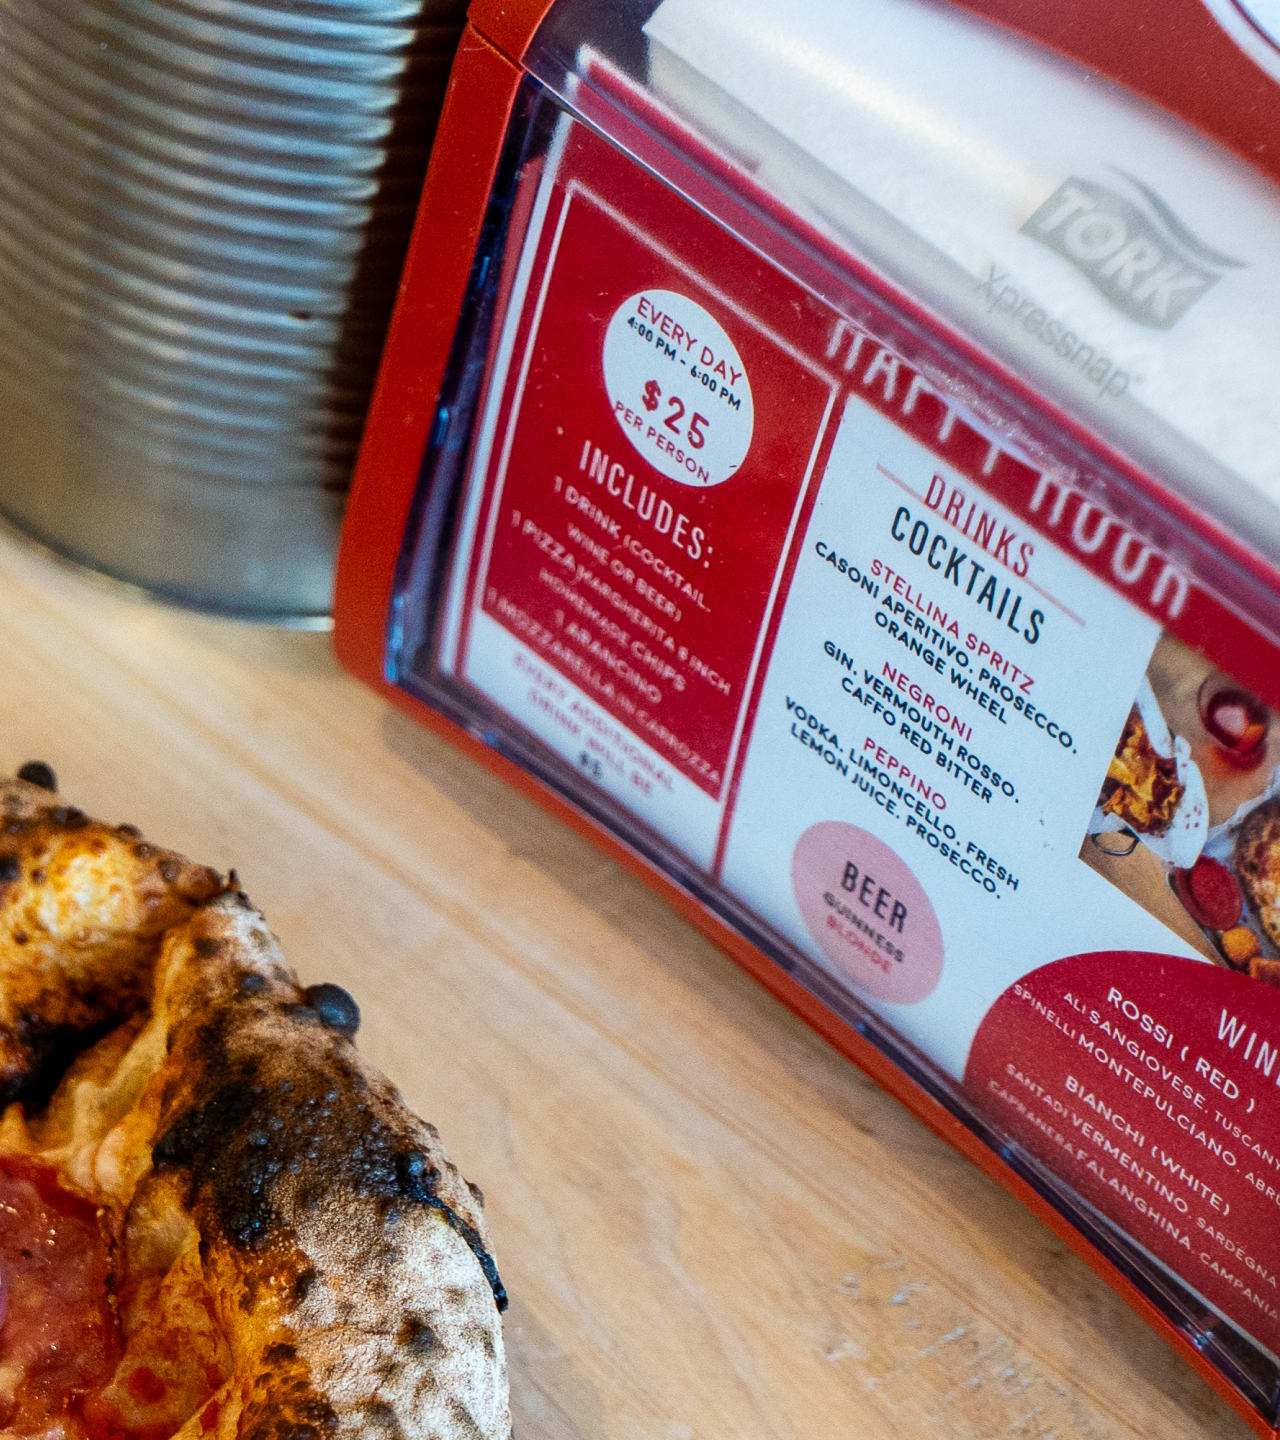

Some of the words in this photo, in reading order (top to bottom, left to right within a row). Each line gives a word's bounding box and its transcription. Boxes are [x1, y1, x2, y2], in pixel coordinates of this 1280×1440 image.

[1037, 186, 1206, 313] TORK
[627, 317, 653, 343] 4:00
[656, 338, 677, 361] PM
[690, 365, 717, 392] 6:00
[720, 387, 742, 411] PM
[637, 297, 697, 351] EVERY
[700, 346, 743, 386] DAY
[614, 400, 644, 431] PER
[646, 426, 710, 484] PERSON
[564, 485, 622, 539] DRINK
[579, 440, 713, 569] INCLUDES:
[924, 474, 1035, 578] DRINKS
[815, 541, 879, 598] CASONI
[890, 506, 1045, 645] COCKTAILS
[871, 559, 960, 639] STELLINA
[965, 633, 1035, 695] SPRITZ
[874, 611, 946, 675] ORANGE
[950, 667, 1009, 725] WHEEL
[841, 677, 896, 727] CAFFO
[900, 722, 932, 755] RED
[935, 750, 993, 804] BITTER
[863, 669, 954, 750] VERMOUTH
[881, 661, 973, 742] NEGRONI
[790, 723, 849, 776] LEMON
[863, 737, 947, 810] PEPPINO
[841, 861, 909, 934] BEER
[966, 841, 1020, 891] FRESH
[1013, 984, 1076, 1039] SPINELLI
[1063, 992, 1087, 1015] ALI
[1107, 987, 1174, 1049] ROSSI
[1195, 1057, 1240, 1100] RED
[1065, 1075, 1145, 1148] BIANCHI
[1150, 1145, 1231, 1217] (WHITE)
[1195, 1217, 1278, 1288] SARDEGNA
[1199, 1252, 1280, 1321] CAMPANIA
